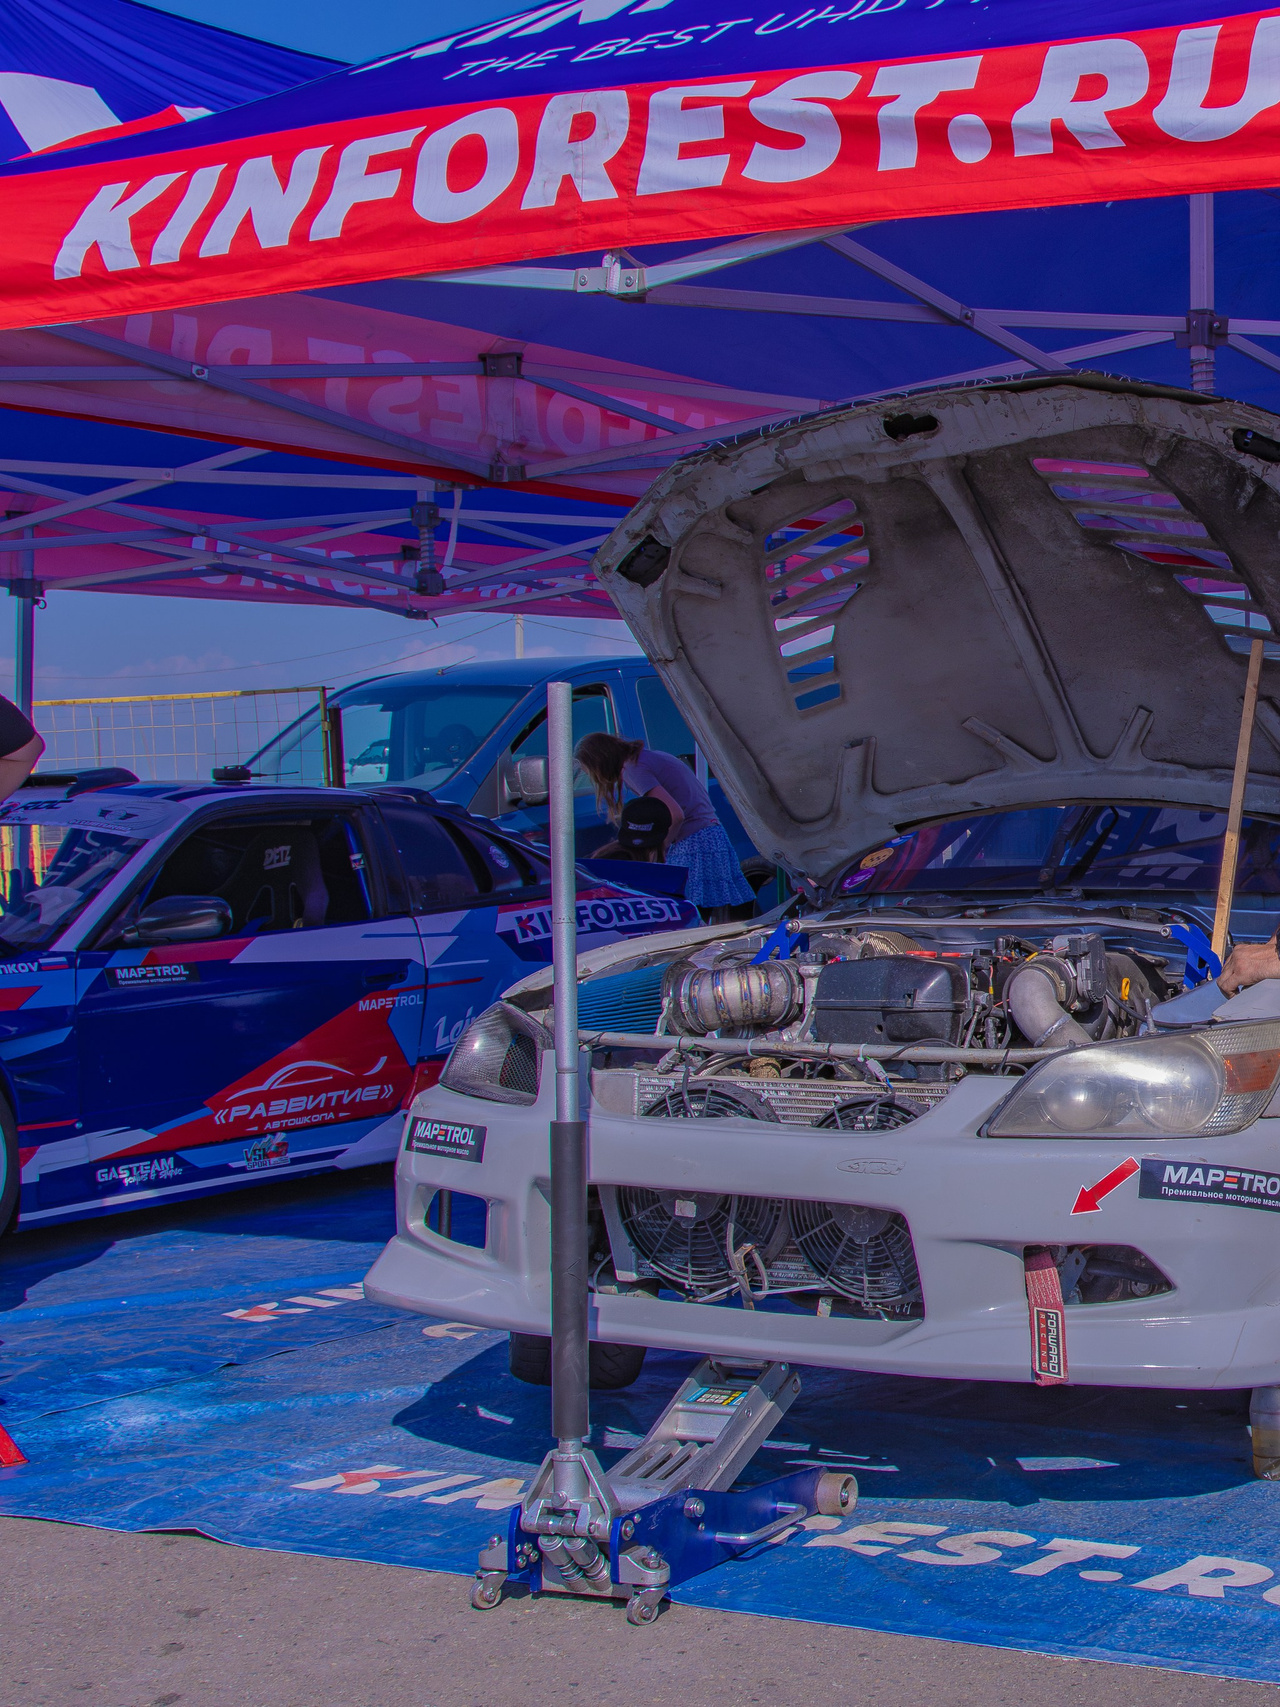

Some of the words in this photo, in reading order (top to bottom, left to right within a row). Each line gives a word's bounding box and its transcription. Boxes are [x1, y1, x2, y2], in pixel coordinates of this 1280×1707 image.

[443, 46, 575, 80] THE
[572, 18, 753, 62] BEST
[516, 896, 682, 943] KIFOREST
[115, 965, 189, 979] MAPETROL
[359, 994, 424, 1011] MAPETROL
[264, 1112, 335, 1130] АВТОШКОЛА
[413, 1121, 476, 1146] MAPETROL
[96, 1157, 175, 1183] GASTEAM
[1161, 1186, 1224, 1200] Премиальное
[1225, 1192, 1262, 1205] моторное
[1040, 1313, 1048, 1369] RACING
[1047, 1312, 1058, 1373] FORWARD
